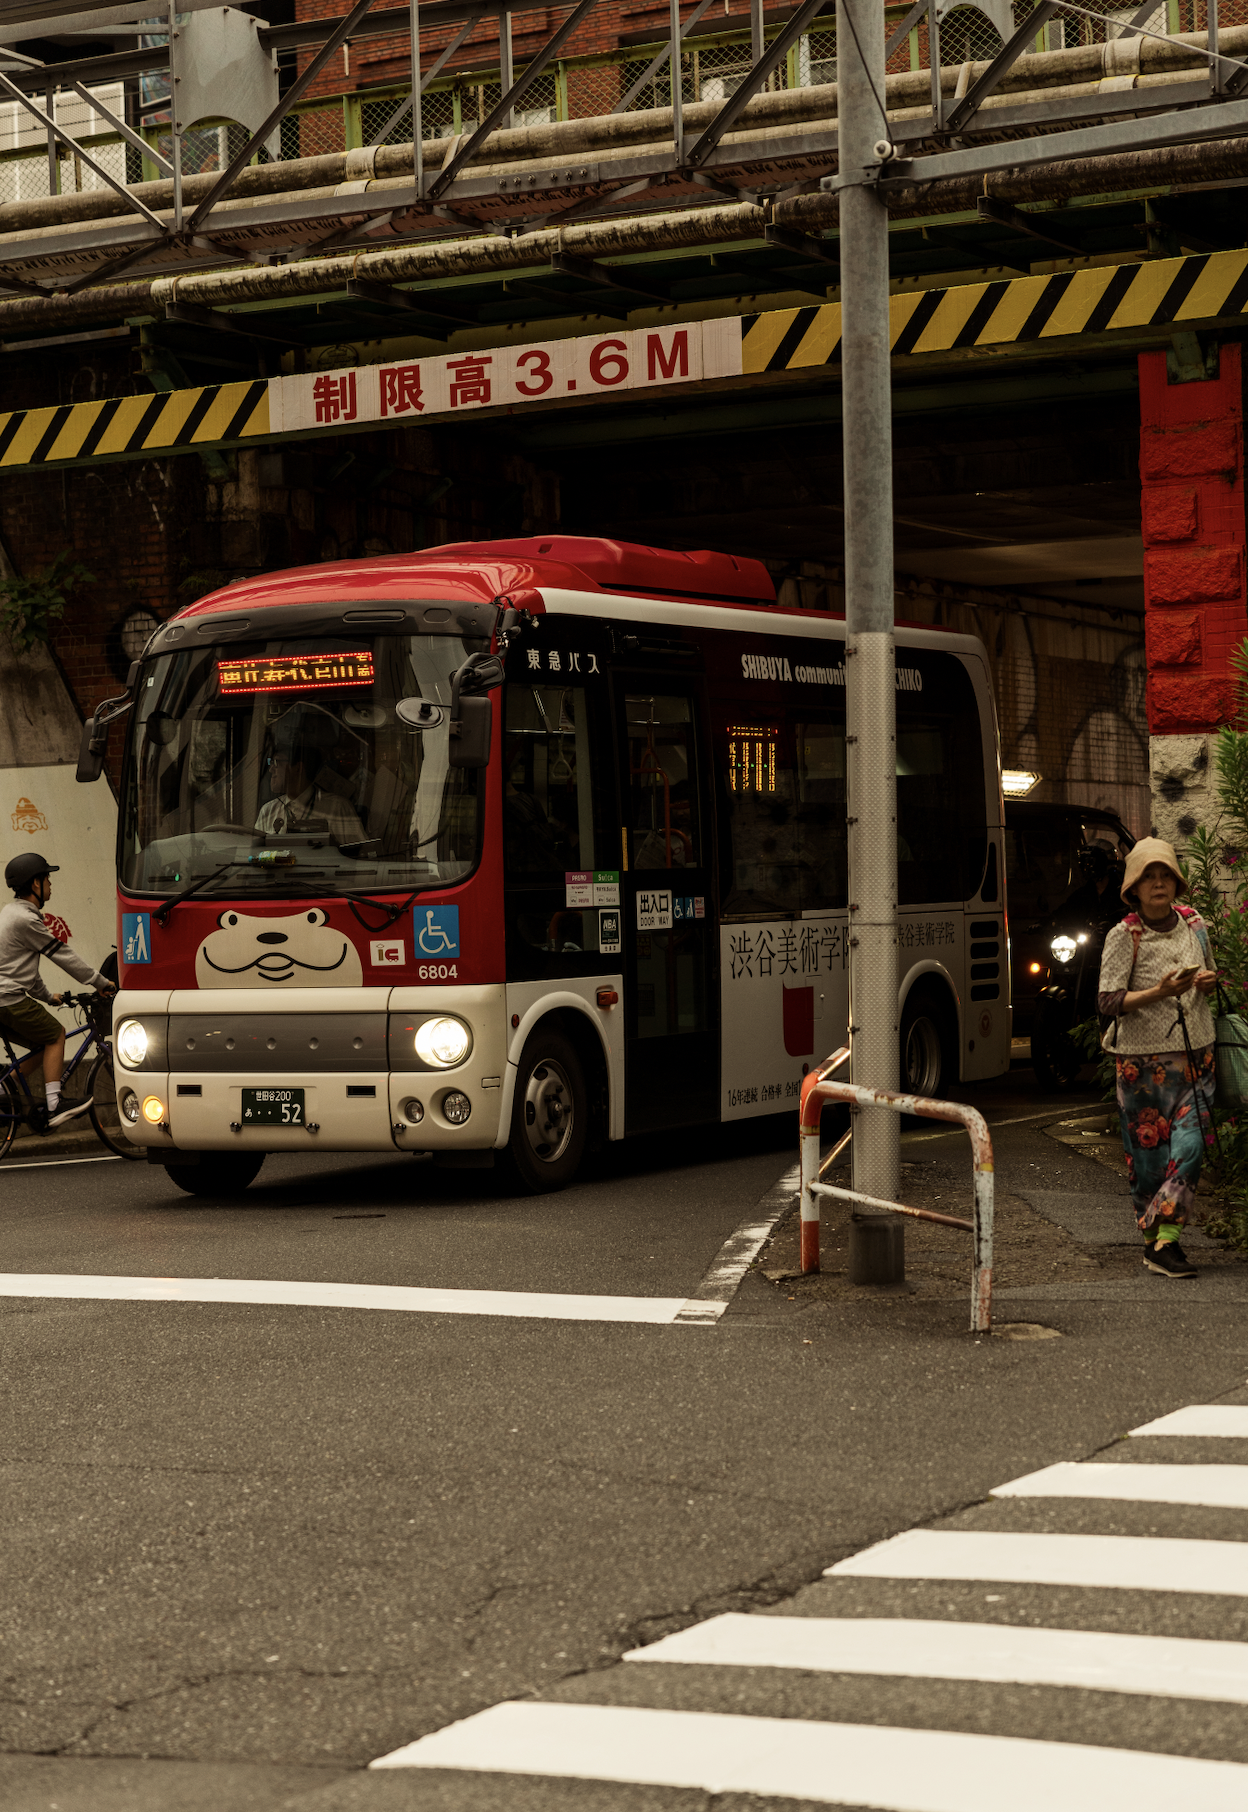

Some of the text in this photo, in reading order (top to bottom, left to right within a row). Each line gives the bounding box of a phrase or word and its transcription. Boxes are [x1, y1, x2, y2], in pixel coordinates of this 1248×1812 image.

[526, 648, 600, 674] 東急バス
[740, 653, 793, 682] SHIBUYA
[640, 893, 669, 914] 出入口
[640, 915, 670, 927] DOOR WAY
[418, 964, 459, 980] 6804
[761, 1083, 782, 1102] 合格率
[244, 1107, 253, 1118] あ
[281, 1103, 302, 1123] 52
